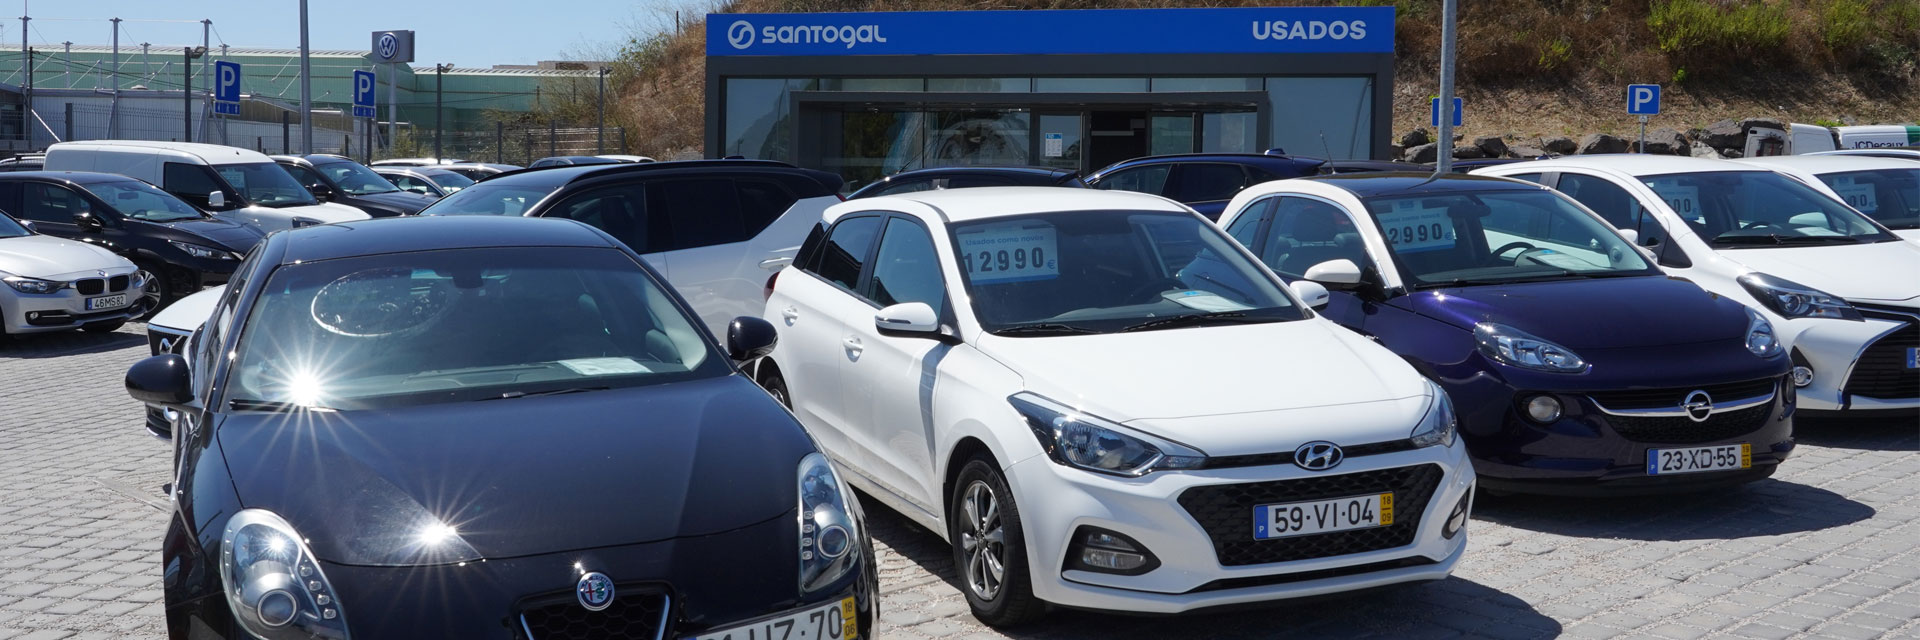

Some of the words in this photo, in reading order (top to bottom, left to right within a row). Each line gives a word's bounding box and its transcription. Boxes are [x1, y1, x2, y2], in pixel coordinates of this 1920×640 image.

[1252, 20, 1367, 40] USADOS
[221, 65, 236, 97] P
[358, 74, 371, 102] P
[1634, 87, 1653, 112] P
[997, 236, 1018, 244] como
[1382, 496, 1391, 505] 18
[1382, 513, 1392, 522] 09
[844, 602, 853, 612] 18
[845, 623, 856, 636] 06
